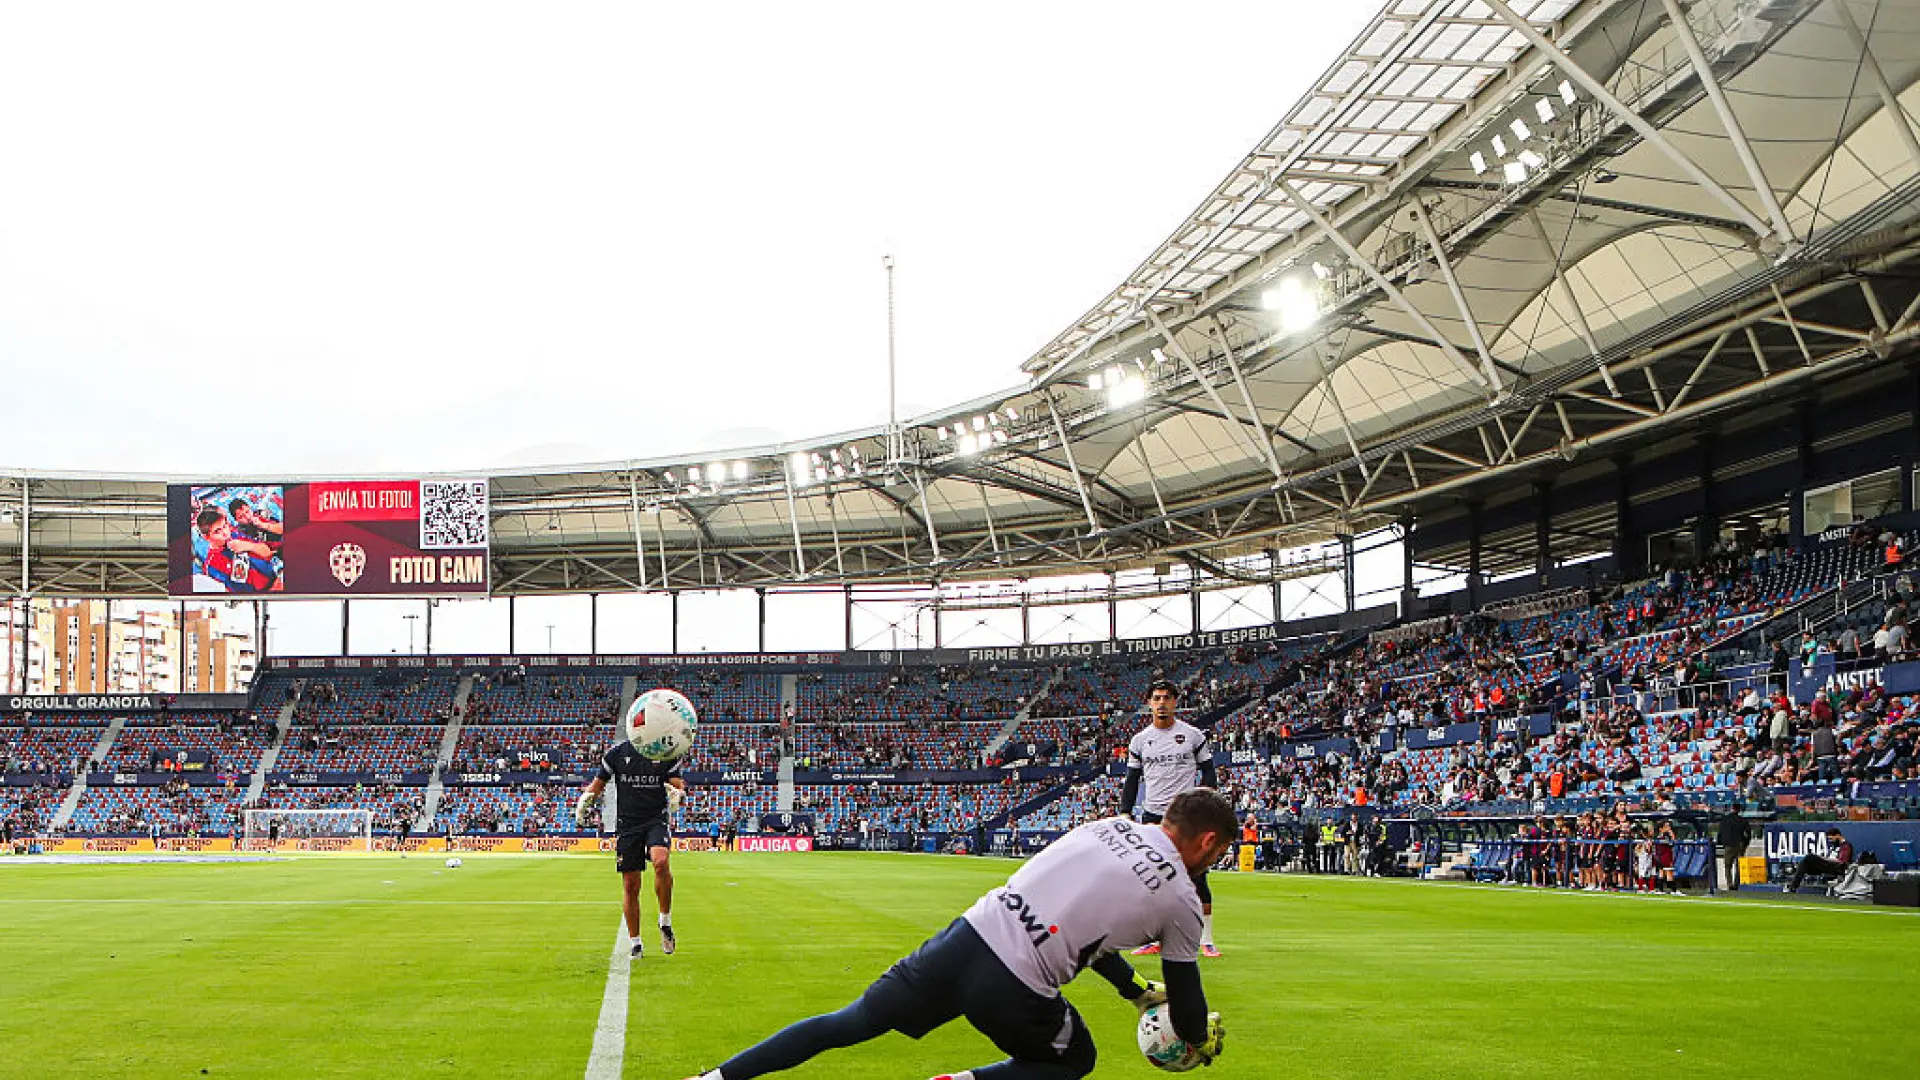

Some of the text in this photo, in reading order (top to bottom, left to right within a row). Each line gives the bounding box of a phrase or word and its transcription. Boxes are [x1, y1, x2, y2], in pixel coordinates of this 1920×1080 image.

[318, 487, 412, 512] ¡ENVÍA TU FOTO!
[390, 555, 483, 584] FOTO CAM
[968, 626, 1278, 661] FIRME TU PASO EL TRIUNFO TE ESPERA
[1826, 666, 1885, 692] AMSTEL
[10, 696, 151, 709] ORGULL GRANOTA
[722, 771, 764, 780] AMSTEL
[742, 839, 792, 851] LALIGA
[1113, 821, 1177, 881] acron
[1767, 831, 1830, 859] LALIGA
